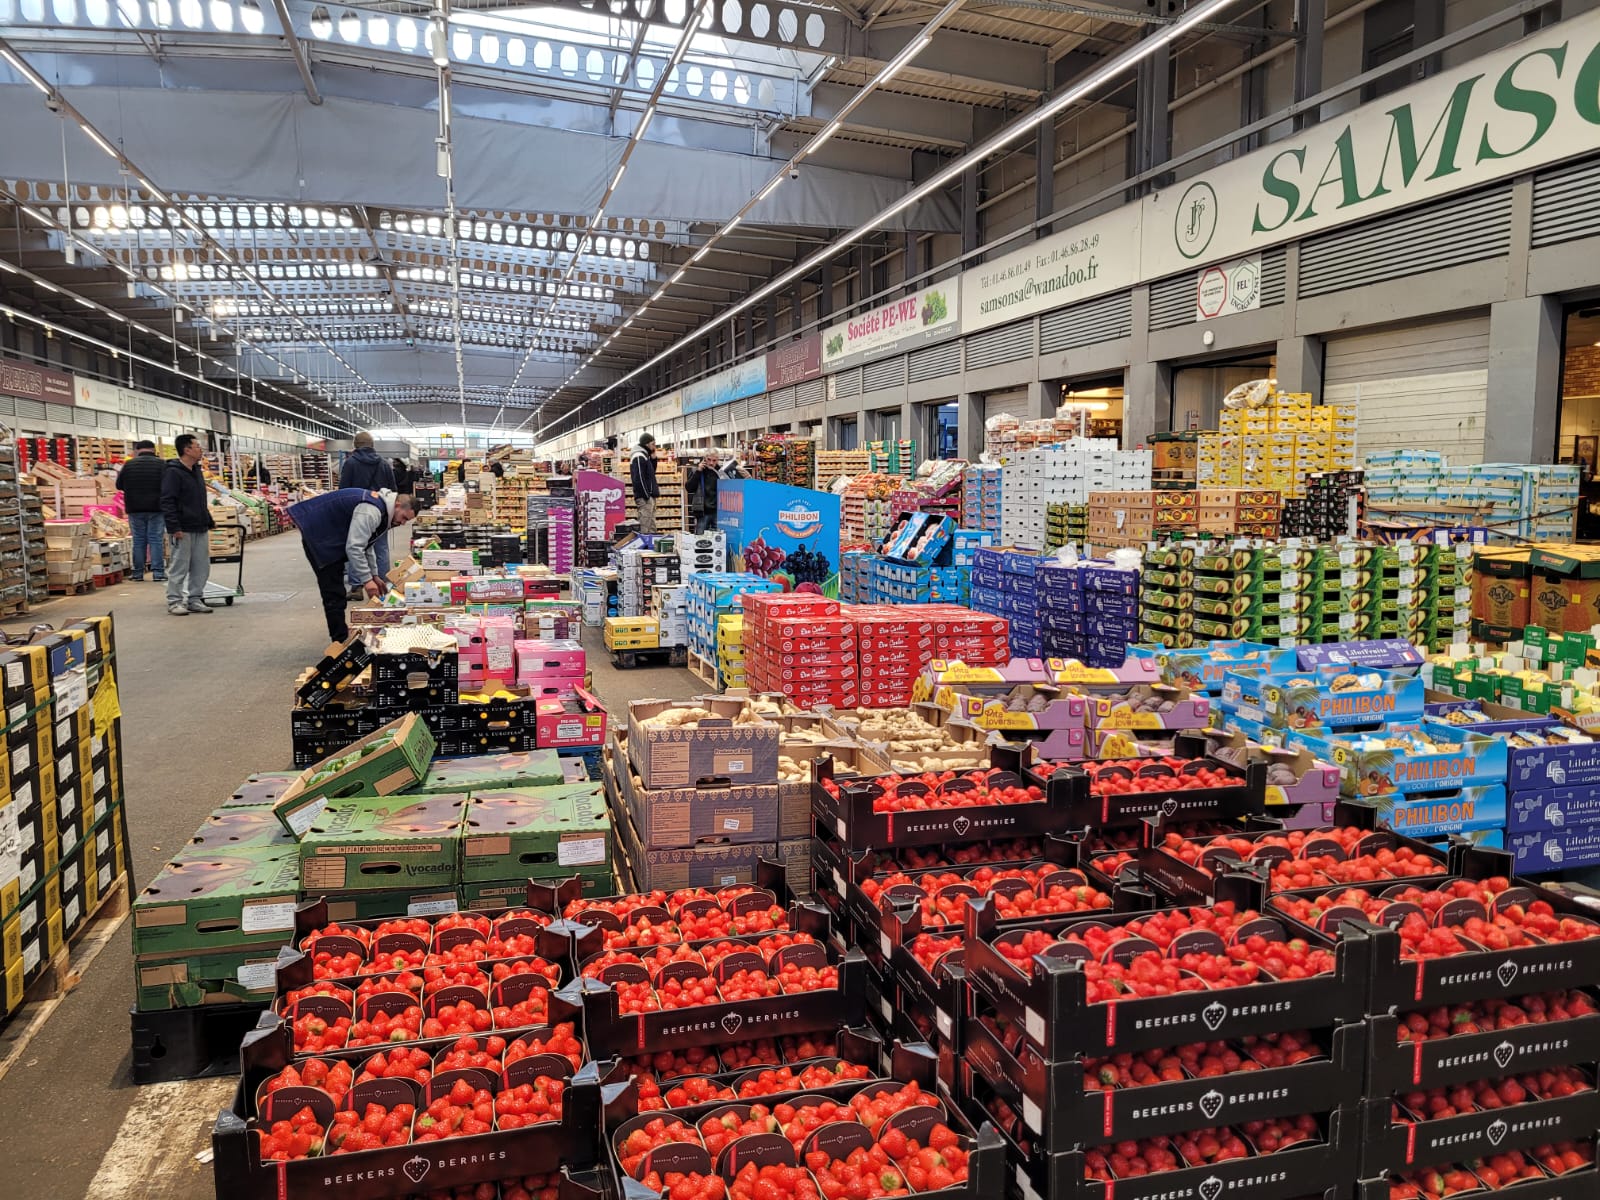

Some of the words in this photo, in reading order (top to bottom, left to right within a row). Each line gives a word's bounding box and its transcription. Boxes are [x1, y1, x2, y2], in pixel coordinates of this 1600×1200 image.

[1252, 40, 1600, 236] SAMS
[1051, 234, 1099, 263] 01.46.86.28.49
[980, 255, 1099, 315] samsonsa@wanadoo.fr
[1236, 278, 1248, 291] FEL
[847, 309, 880, 341] Société
[779, 512, 819, 521] PHILIBON
[1271, 691, 1276, 701] 5
[1320, 694, 1395, 716] PHILIBON
[1357, 713, 1384, 723] L'ORIGINE
[1337, 752, 1343, 762] 5
[1395, 757, 1476, 782] PHILIBON
[1434, 778, 1463, 788] L'ORIGINE
[1120, 804, 1158, 814] BEEKERS
[1181, 800, 1218, 809] BERRIES
[1395, 801, 1475, 827] PHILIBON
[907, 822, 949, 832] BEEKERS
[974, 818, 1016, 827] BERRIES
[1434, 823, 1462, 833] L'ORIGINE
[1439, 970, 1492, 985] BEEKERS
[1522, 960, 1573, 974] BERRIES
[663, 1021, 716, 1035] BEEKERS
[747, 1011, 800, 1023] BERRIES
[1135, 1012, 1197, 1029] BEEKERS
[1232, 1001, 1292, 1017] BERRIES
[1437, 1051, 1489, 1068] BEEKERS
[1519, 1040, 1569, 1055] BERRIES
[1133, 1101, 1194, 1118] BEEKERS
[1229, 1088, 1289, 1105] BERRIES
[1431, 1130, 1482, 1147] BEEKERS
[1512, 1116, 1561, 1132] BERRIES
[324, 1167, 395, 1186] BEEKERS
[438, 1151, 507, 1169] BERRIES
[1228, 1172, 1287, 1189] BERRIES
